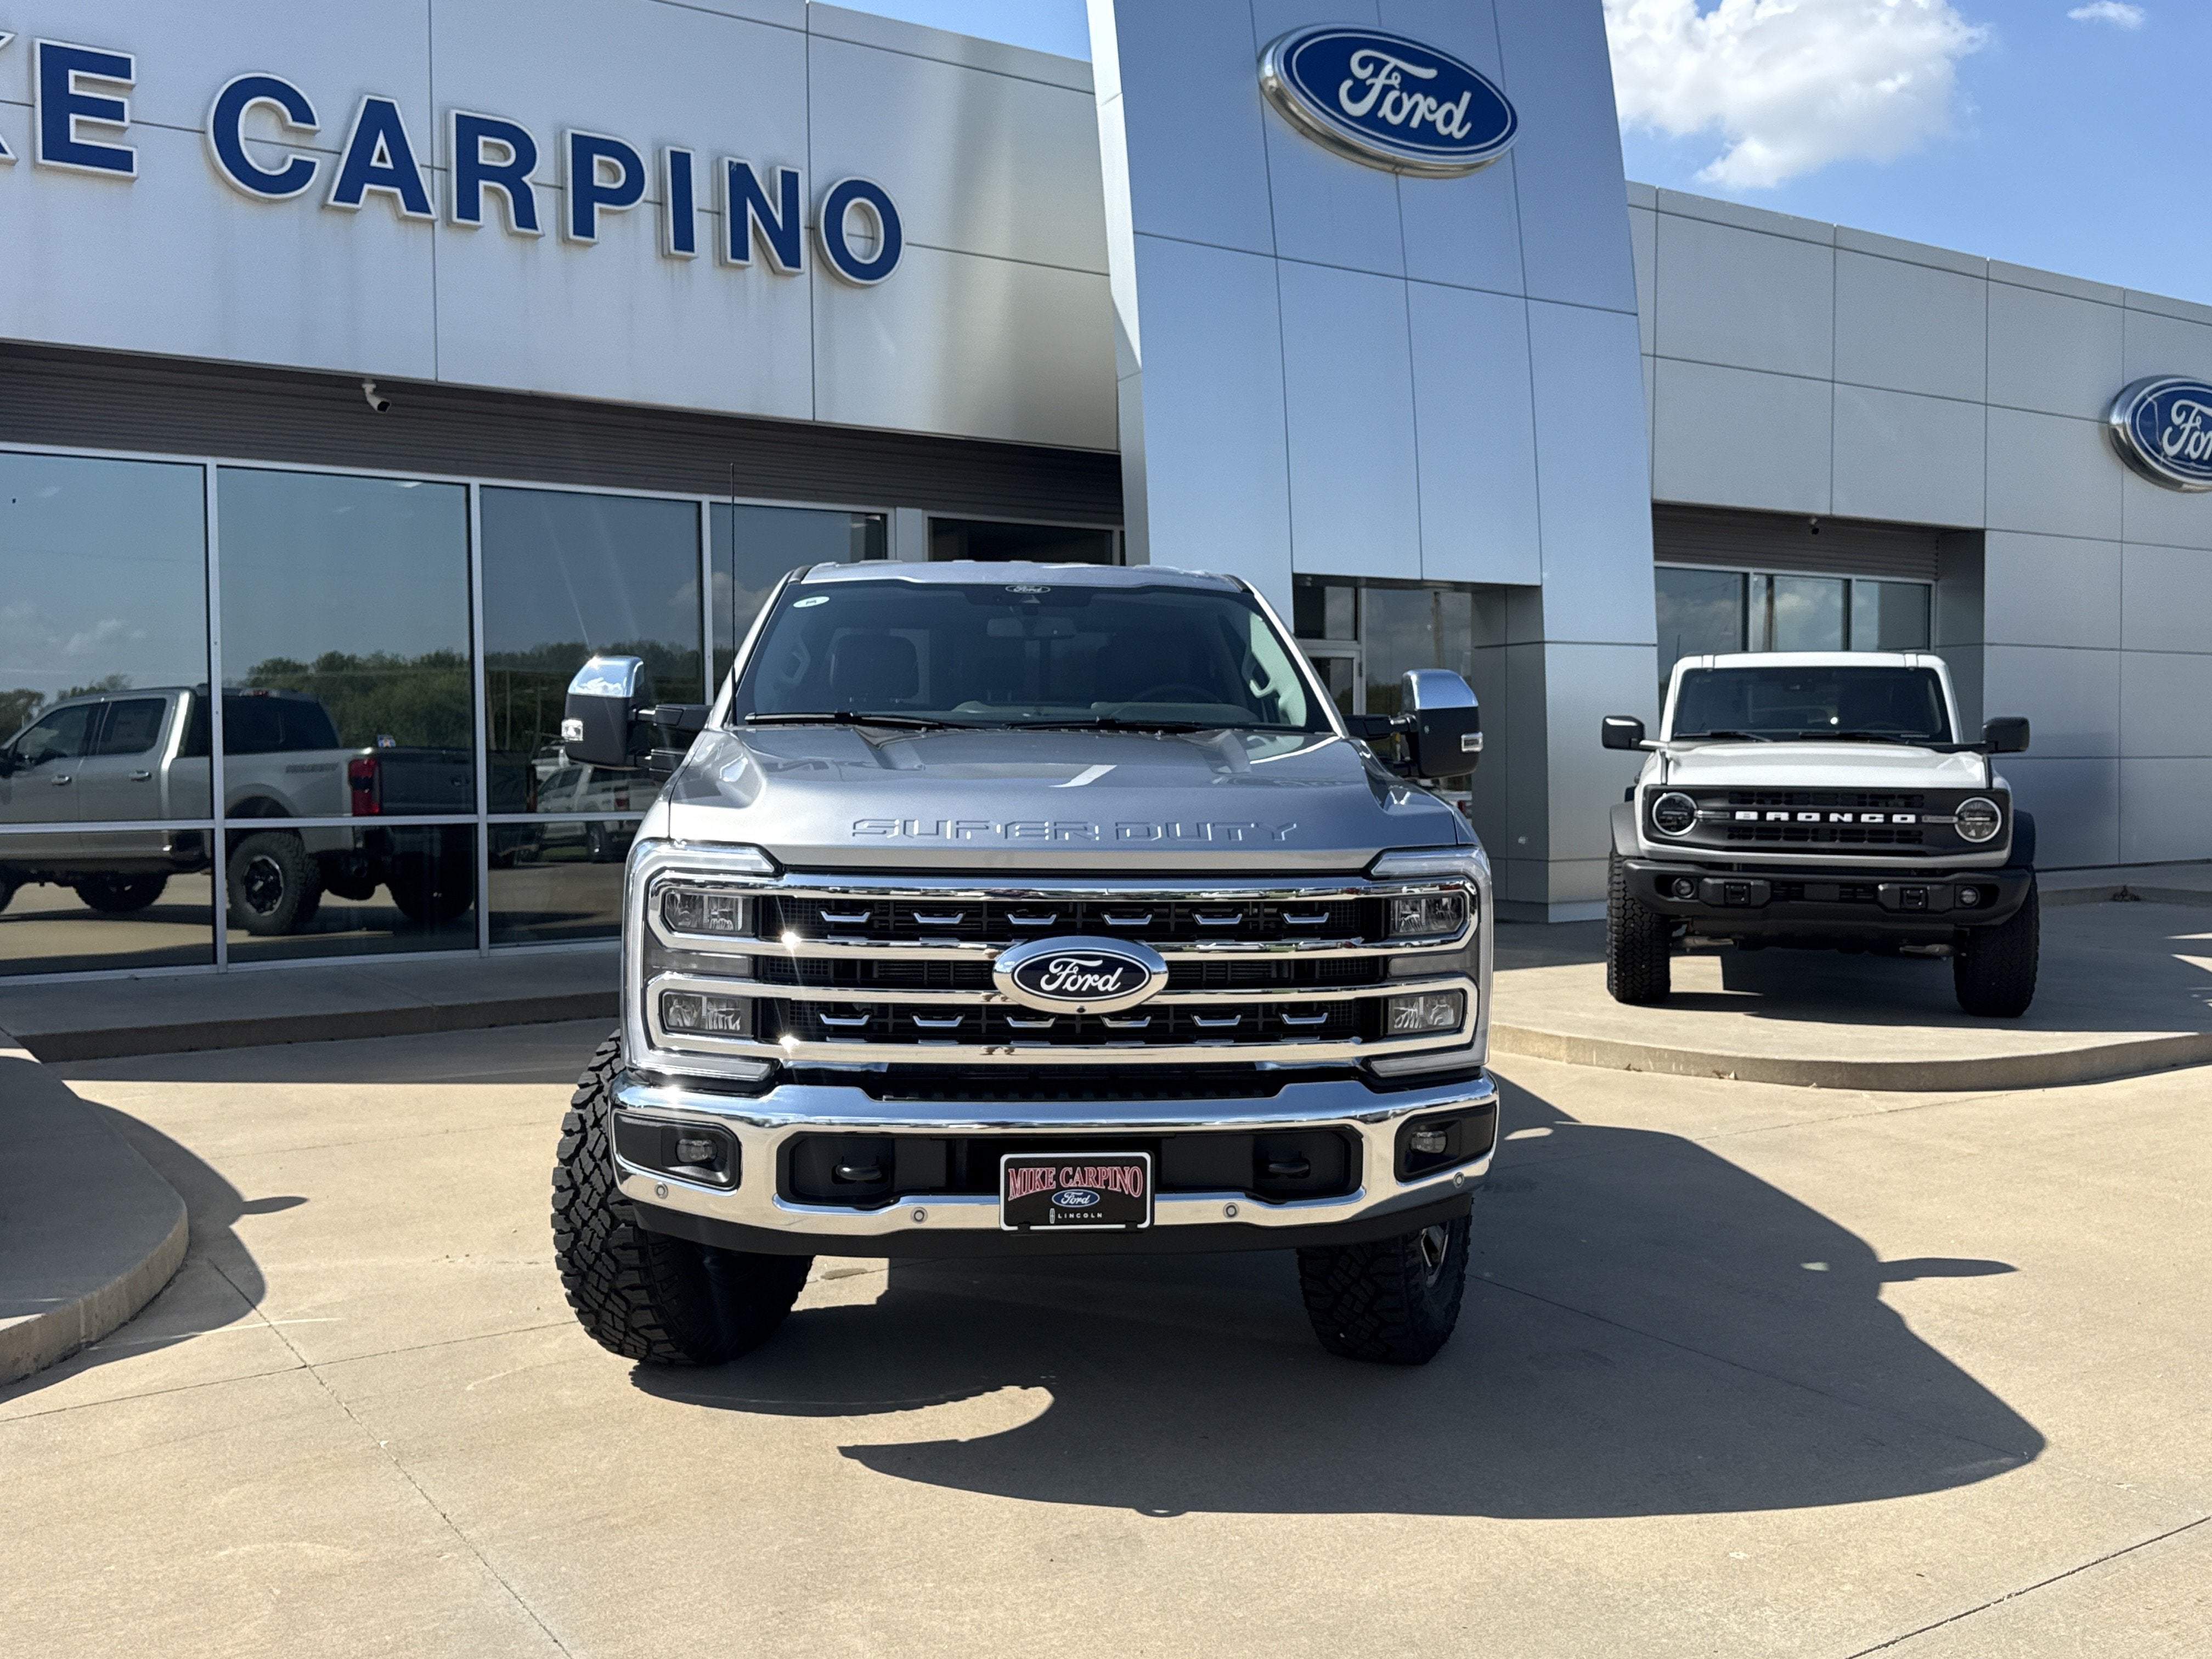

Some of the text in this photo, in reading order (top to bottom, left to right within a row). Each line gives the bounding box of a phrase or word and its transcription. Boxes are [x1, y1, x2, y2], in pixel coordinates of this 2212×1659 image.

[1339, 48, 1472, 139] Ford
[0, 31, 905, 286] E CARPINO
[852, 819, 1297, 842] SUPER DUTY
[1735, 811, 1916, 823] BRONCO
[1040, 957, 1124, 991] Ford
[1008, 1166, 1143, 1201] MIKE CARPINO
[1060, 1192, 1090, 1205] Ford
